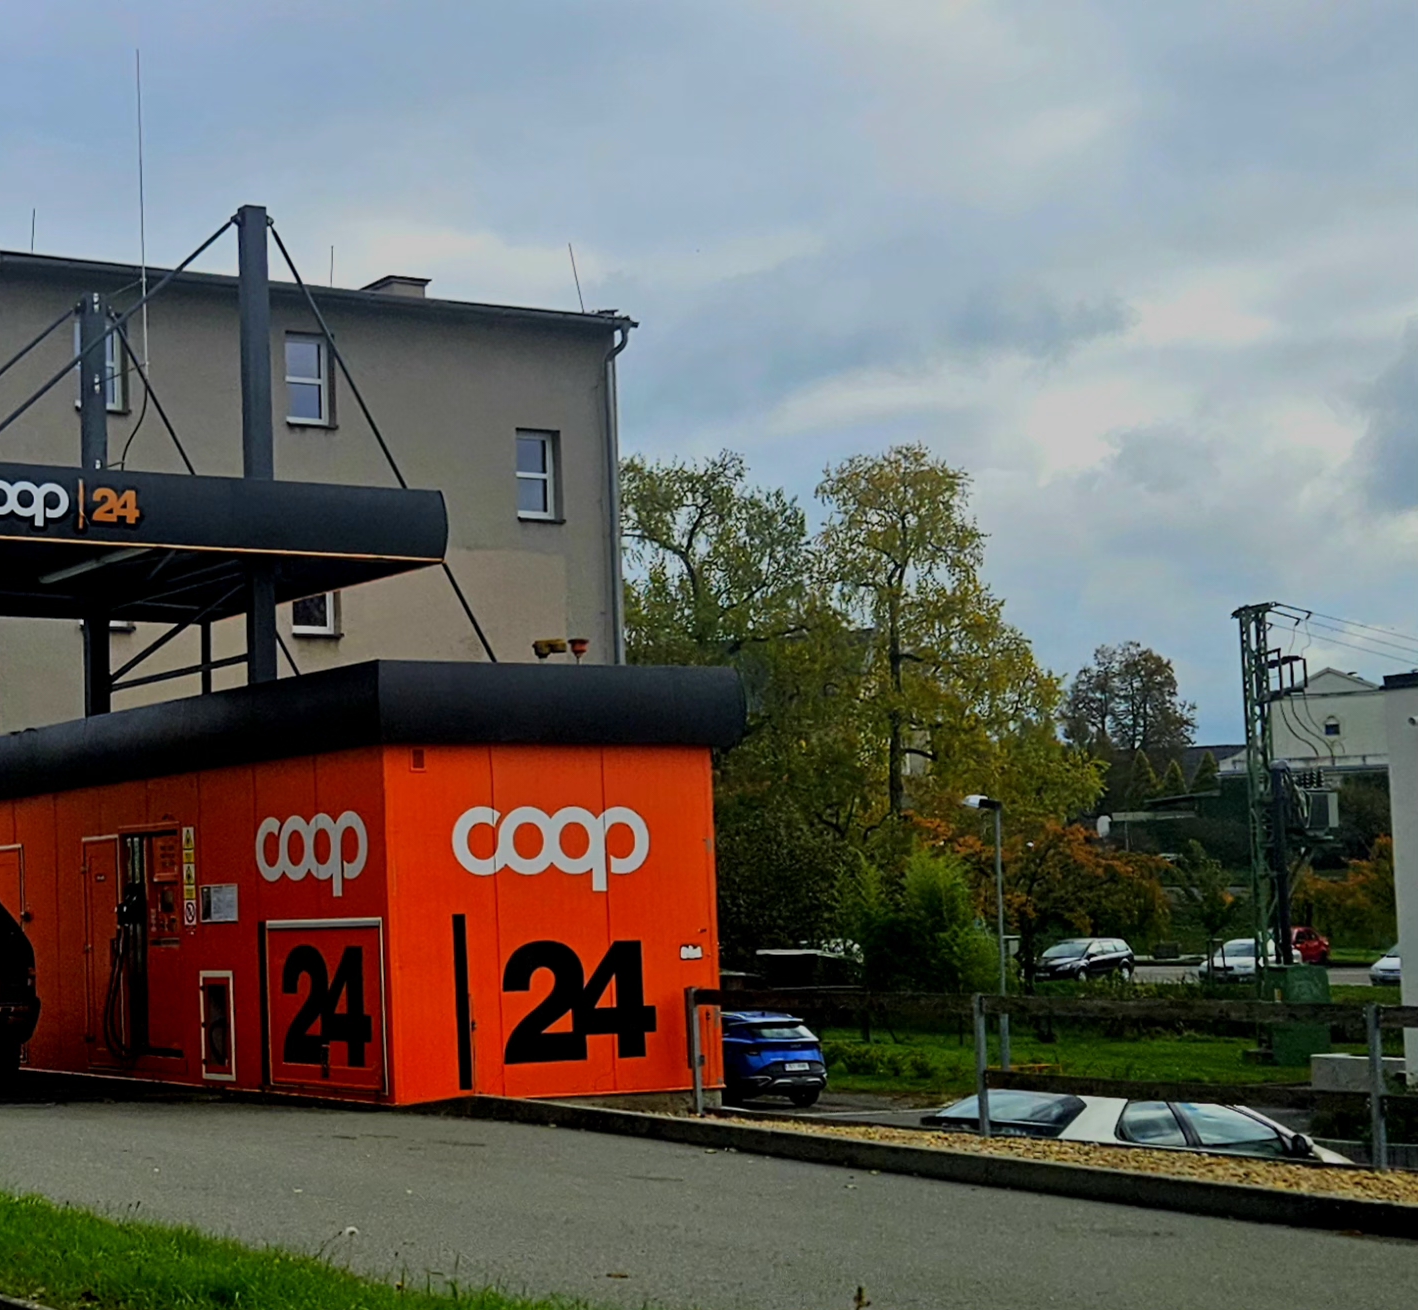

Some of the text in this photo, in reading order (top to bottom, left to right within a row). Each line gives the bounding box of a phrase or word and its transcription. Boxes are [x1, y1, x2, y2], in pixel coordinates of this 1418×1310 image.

[91, 487, 140, 525] 24
[255, 810, 369, 897] coop
[452, 806, 649, 892] coop
[282, 944, 372, 1067] 24
[502, 939, 657, 1065] 24
